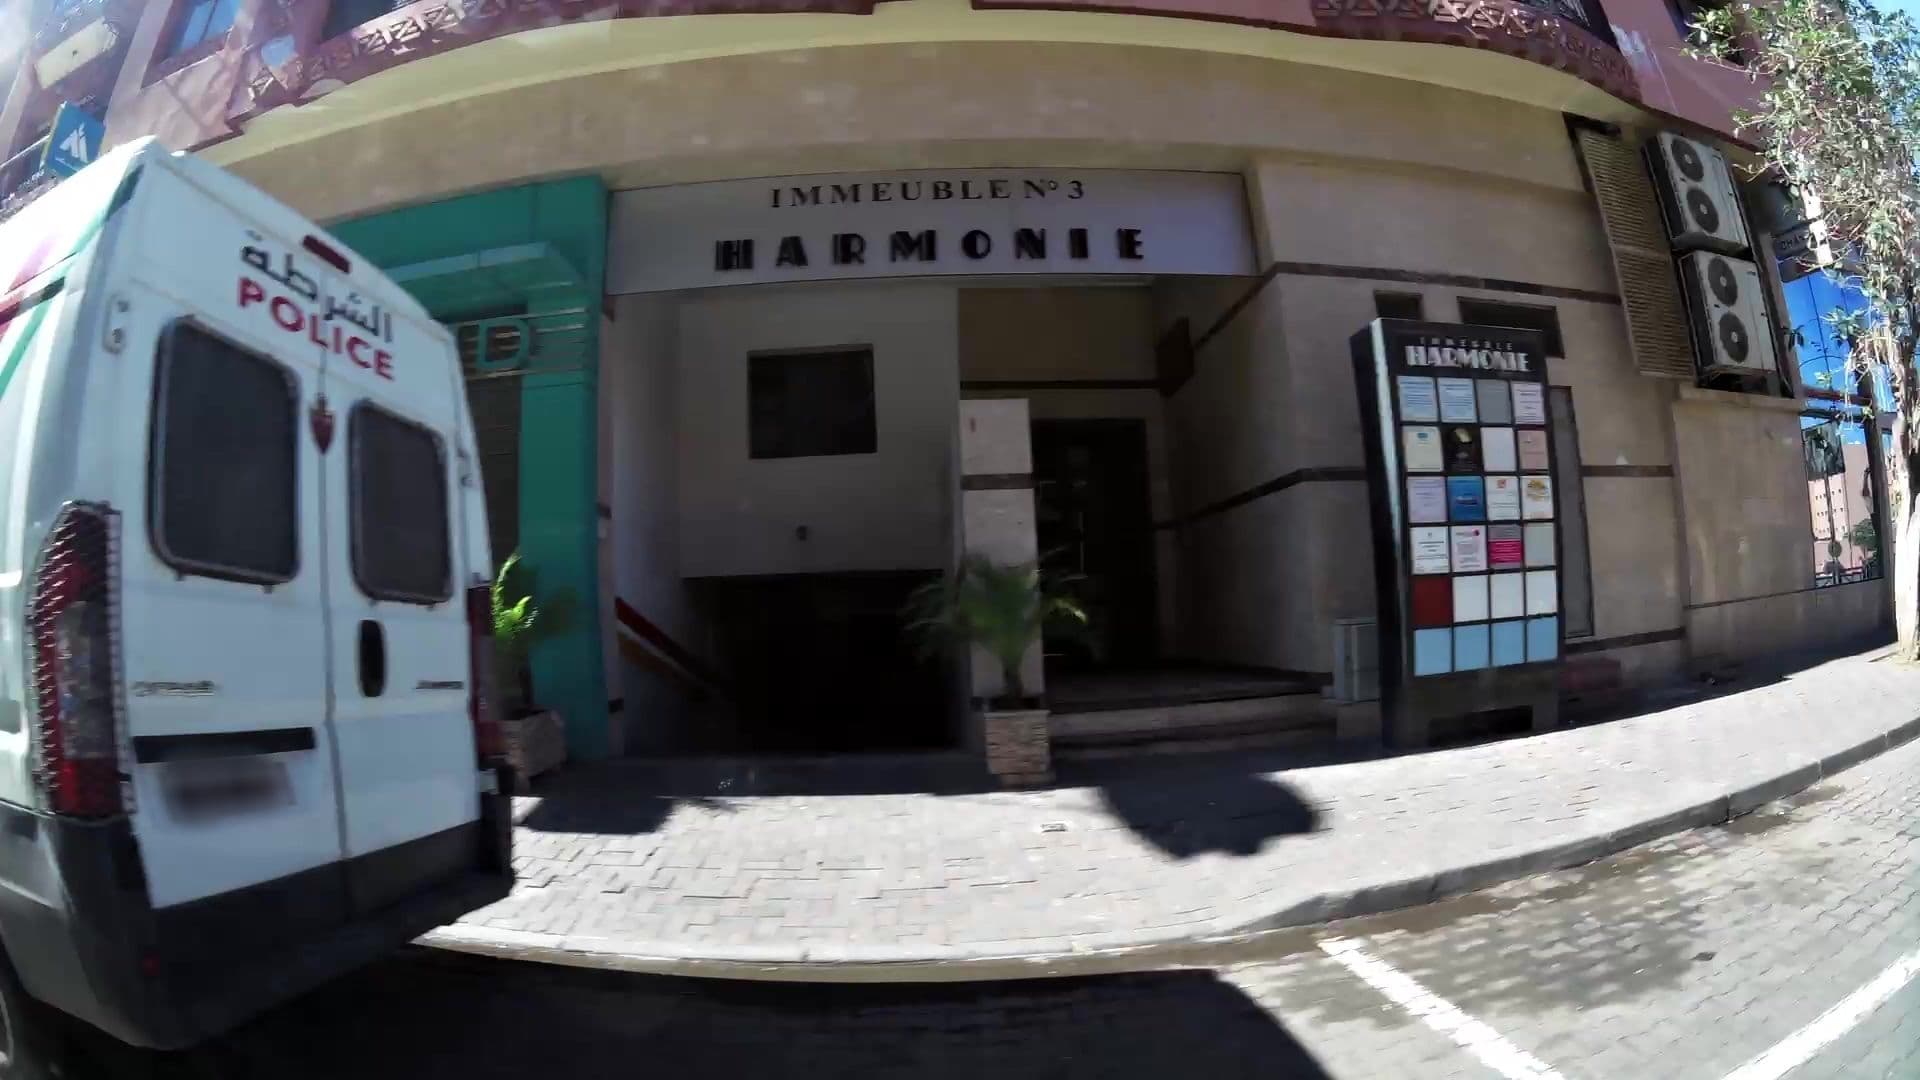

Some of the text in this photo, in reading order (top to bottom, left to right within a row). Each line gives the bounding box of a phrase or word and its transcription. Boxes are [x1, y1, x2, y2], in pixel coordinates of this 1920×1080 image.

[771, 178, 1011, 209] IMMEUBLE
[1067, 179, 1086, 200] 3
[714, 227, 1145, 272] HARMONIE
[241, 229, 394, 342] الشرطة
[238, 277, 395, 381] POLICE
[1404, 344, 1530, 372] HARMONIE
